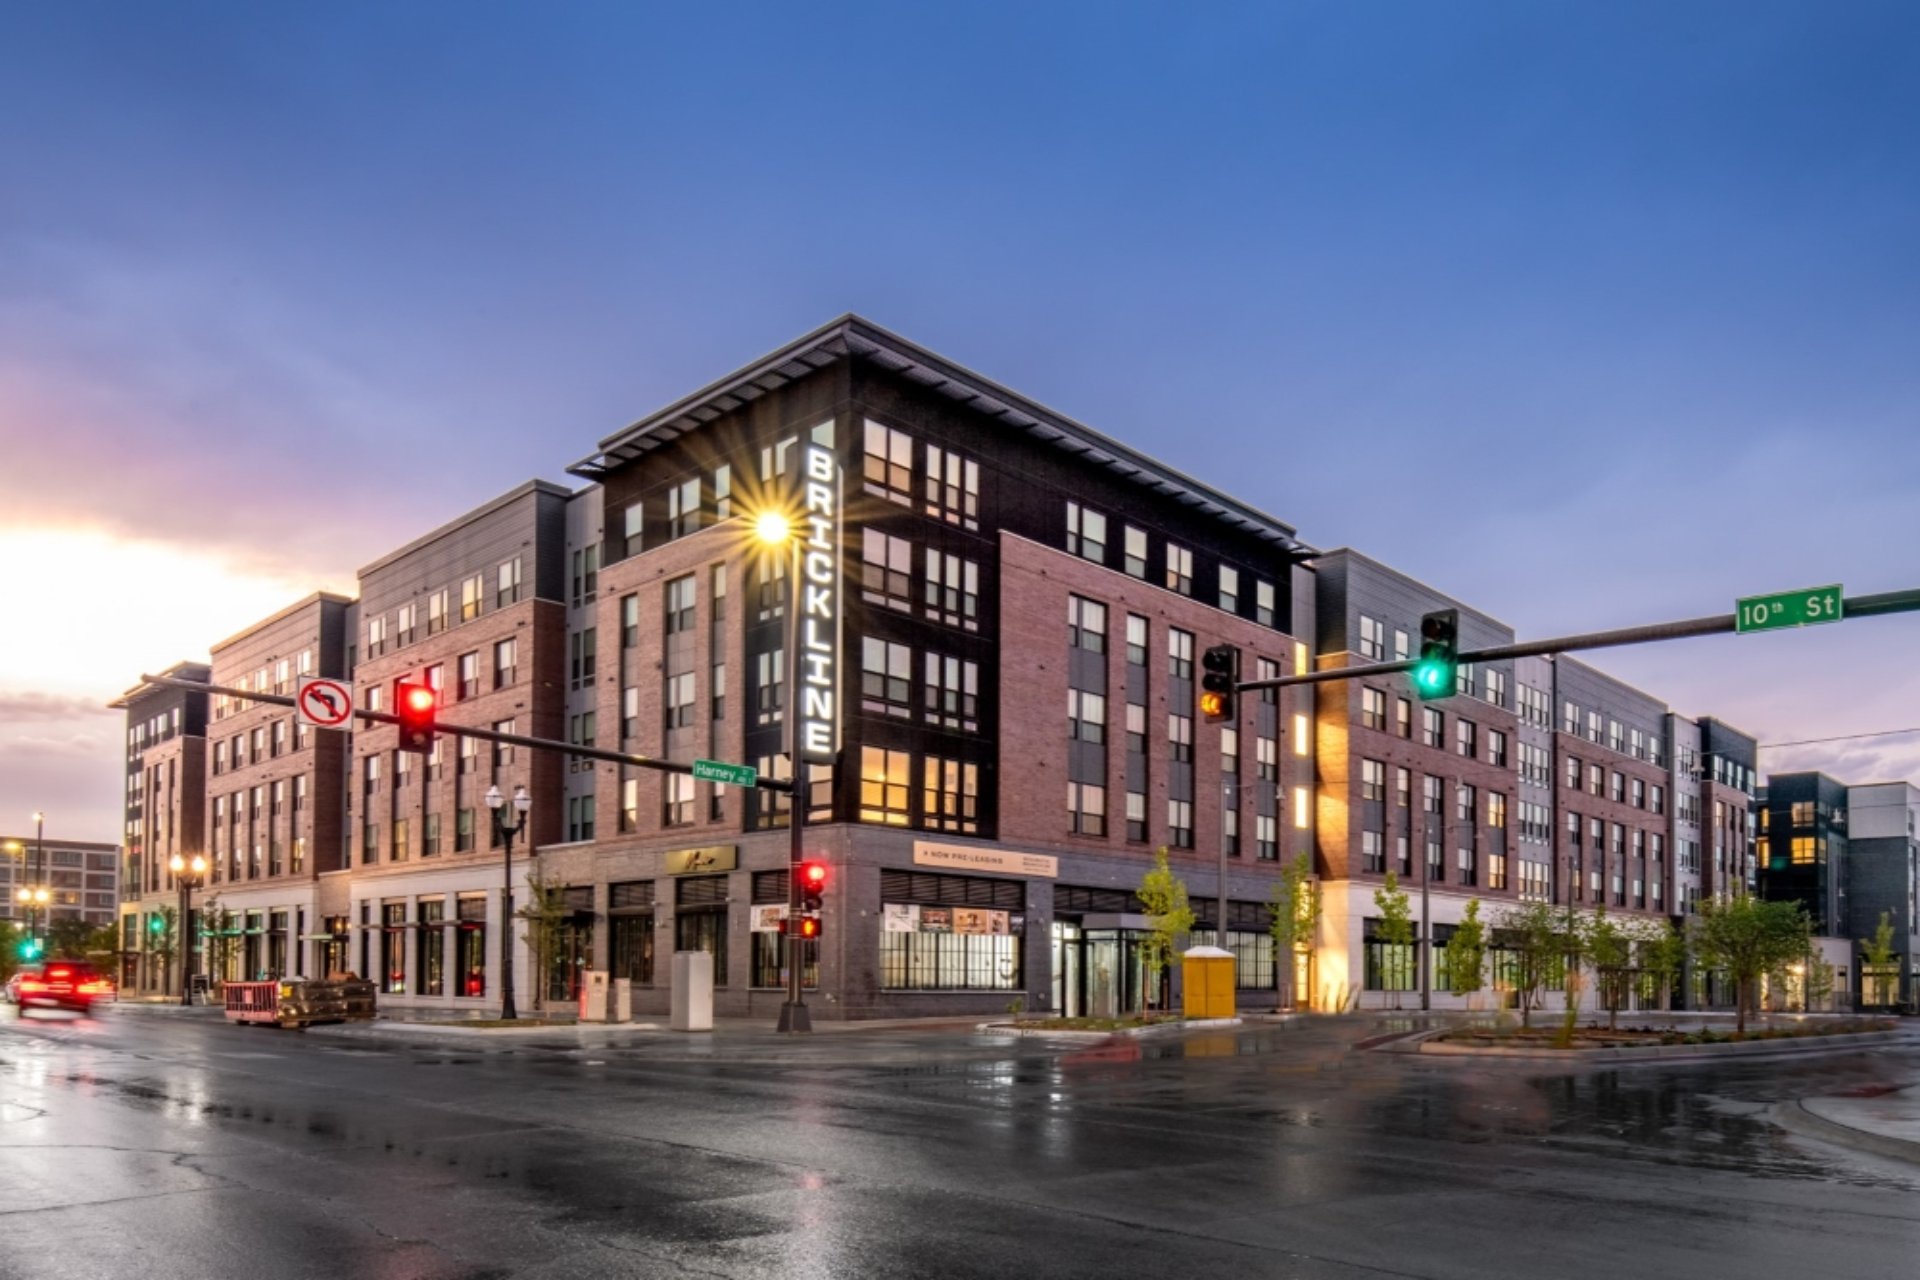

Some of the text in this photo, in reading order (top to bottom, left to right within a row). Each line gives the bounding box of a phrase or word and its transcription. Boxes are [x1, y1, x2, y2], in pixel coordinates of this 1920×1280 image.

[806, 448, 832, 752] BRICKLINE
[1743, 595, 1834, 625] 10th St
[696, 763, 736, 783] Harney
[930, 850, 949, 859] NOW
